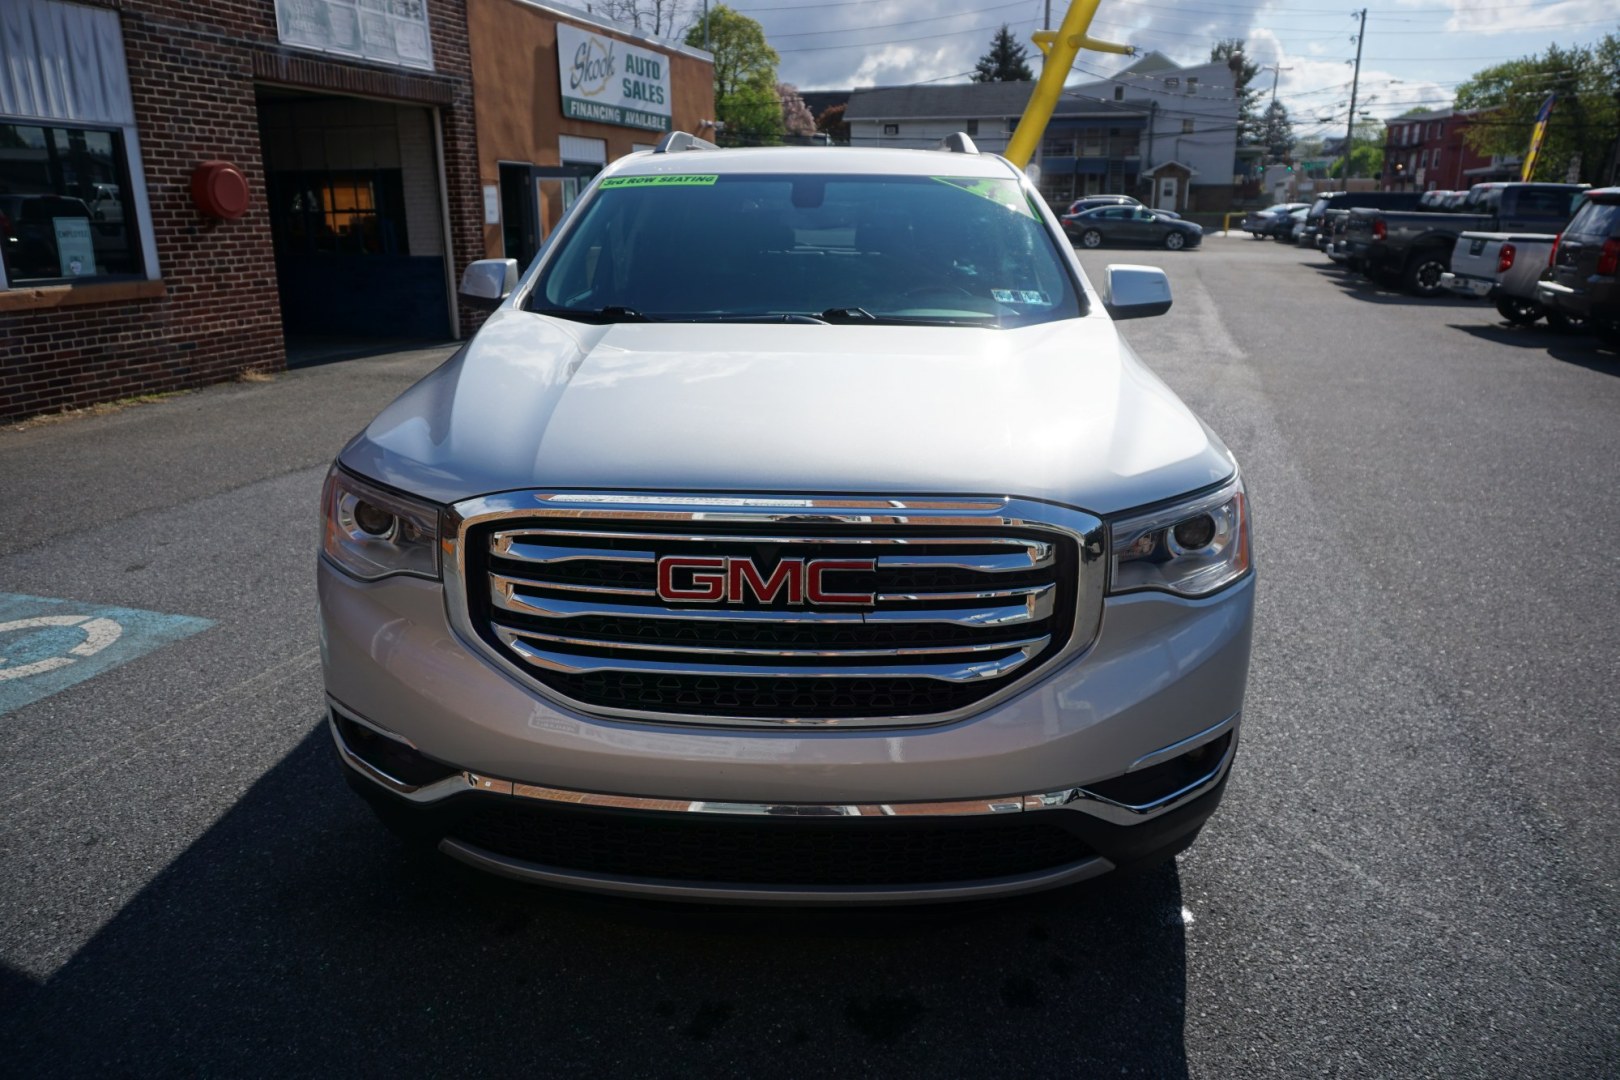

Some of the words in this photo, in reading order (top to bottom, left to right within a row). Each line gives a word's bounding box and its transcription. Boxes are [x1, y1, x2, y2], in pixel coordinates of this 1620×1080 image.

[570, 40, 616, 89] Skook
[625, 54, 660, 80] AUTO
[622, 78, 664, 105] SALES
[570, 101, 621, 122] FINANCING
[624, 111, 667, 129] AVAILABLE
[603, 178, 626, 186] 3rd
[626, 177, 656, 185] ROW
[658, 175, 714, 183] SEATING
[657, 555, 876, 606] GMC
